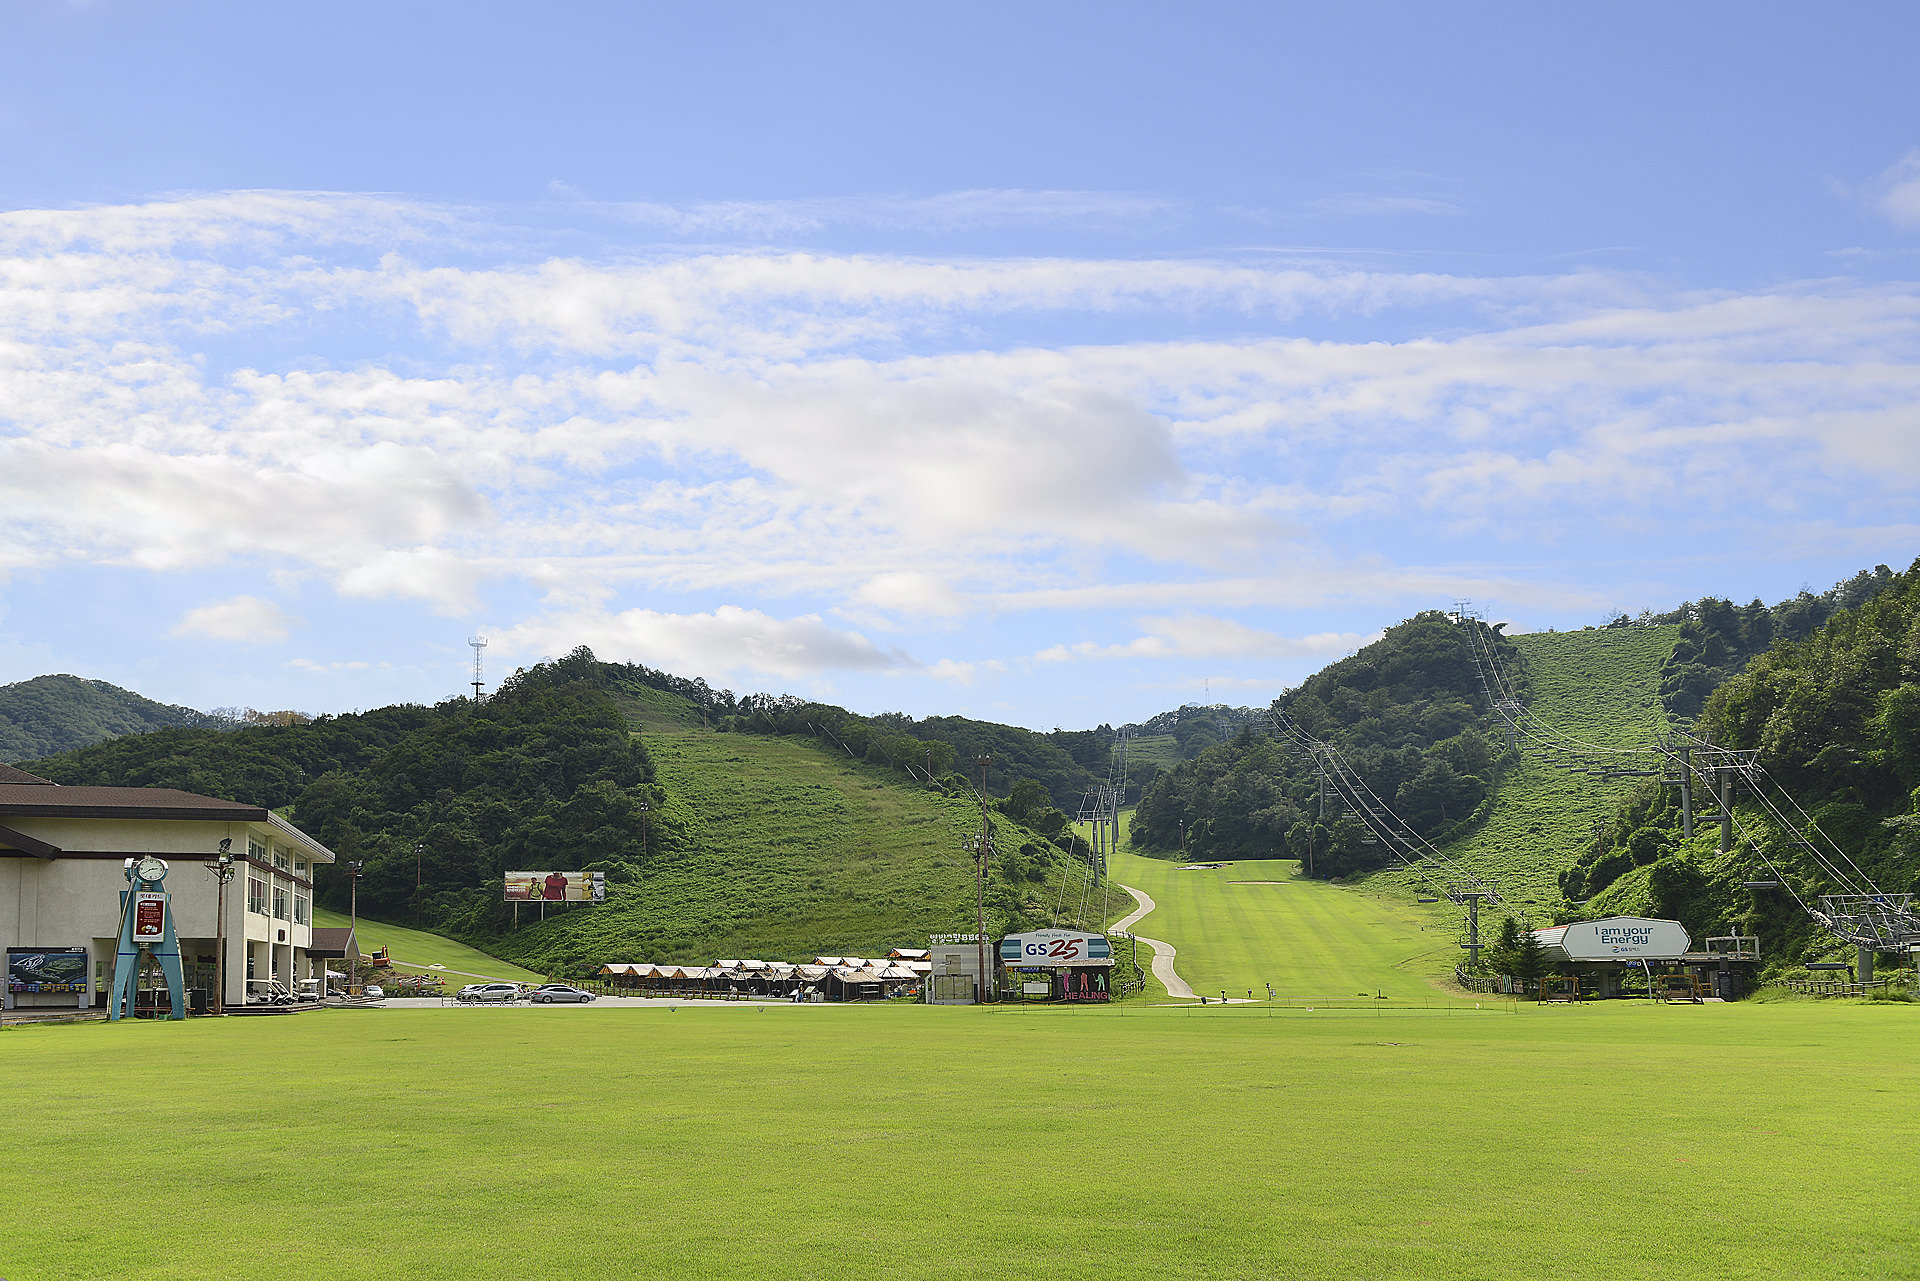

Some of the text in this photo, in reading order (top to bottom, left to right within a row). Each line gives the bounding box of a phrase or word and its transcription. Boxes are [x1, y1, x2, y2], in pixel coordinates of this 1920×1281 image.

[1595, 926, 1653, 937] I am your
[1601, 935, 1648, 945] Energy
[1064, 991, 1108, 1000] HEALING
